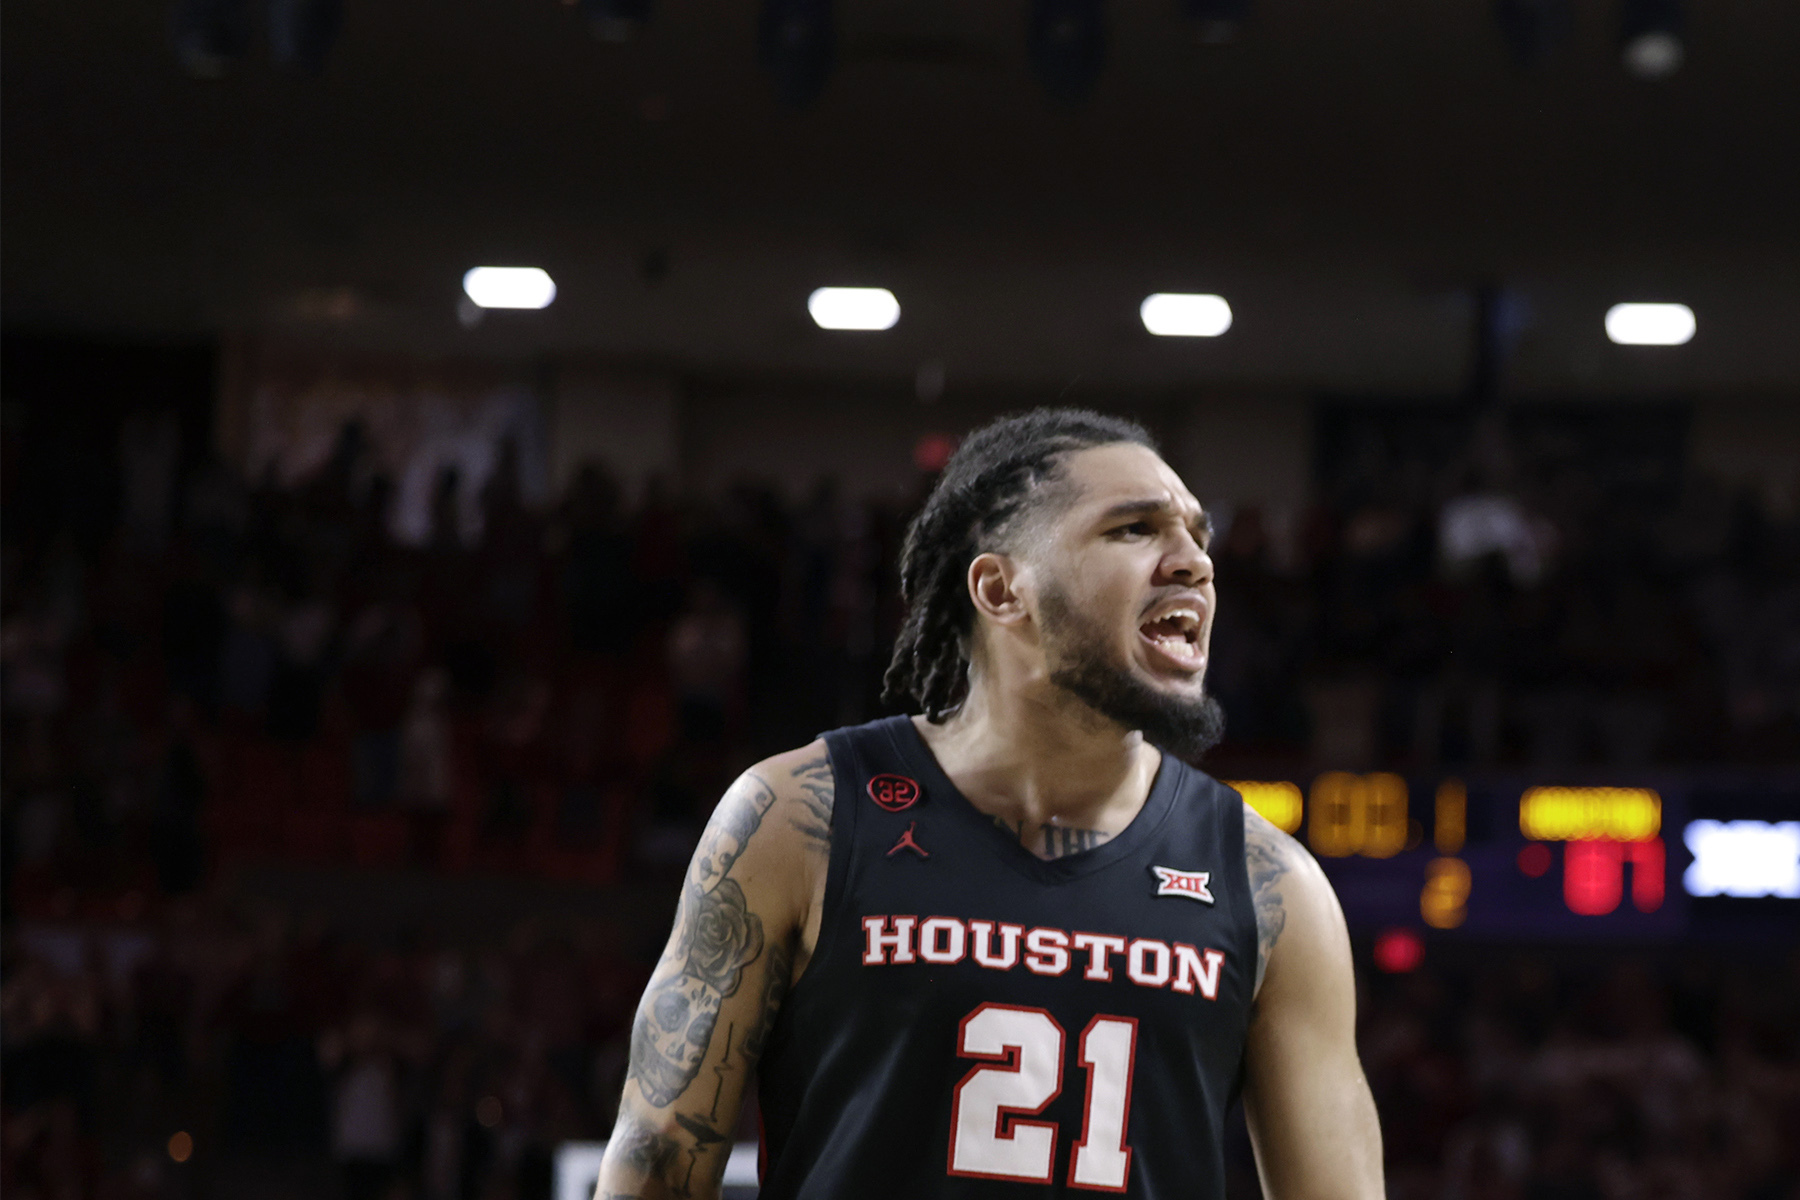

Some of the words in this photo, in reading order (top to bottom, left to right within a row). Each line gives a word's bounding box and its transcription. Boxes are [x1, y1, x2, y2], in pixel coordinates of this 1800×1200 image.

[878, 779, 912, 803] 32
[862, 914, 1225, 1001] HOUSTON
[946, 1001, 1140, 1194] 21
